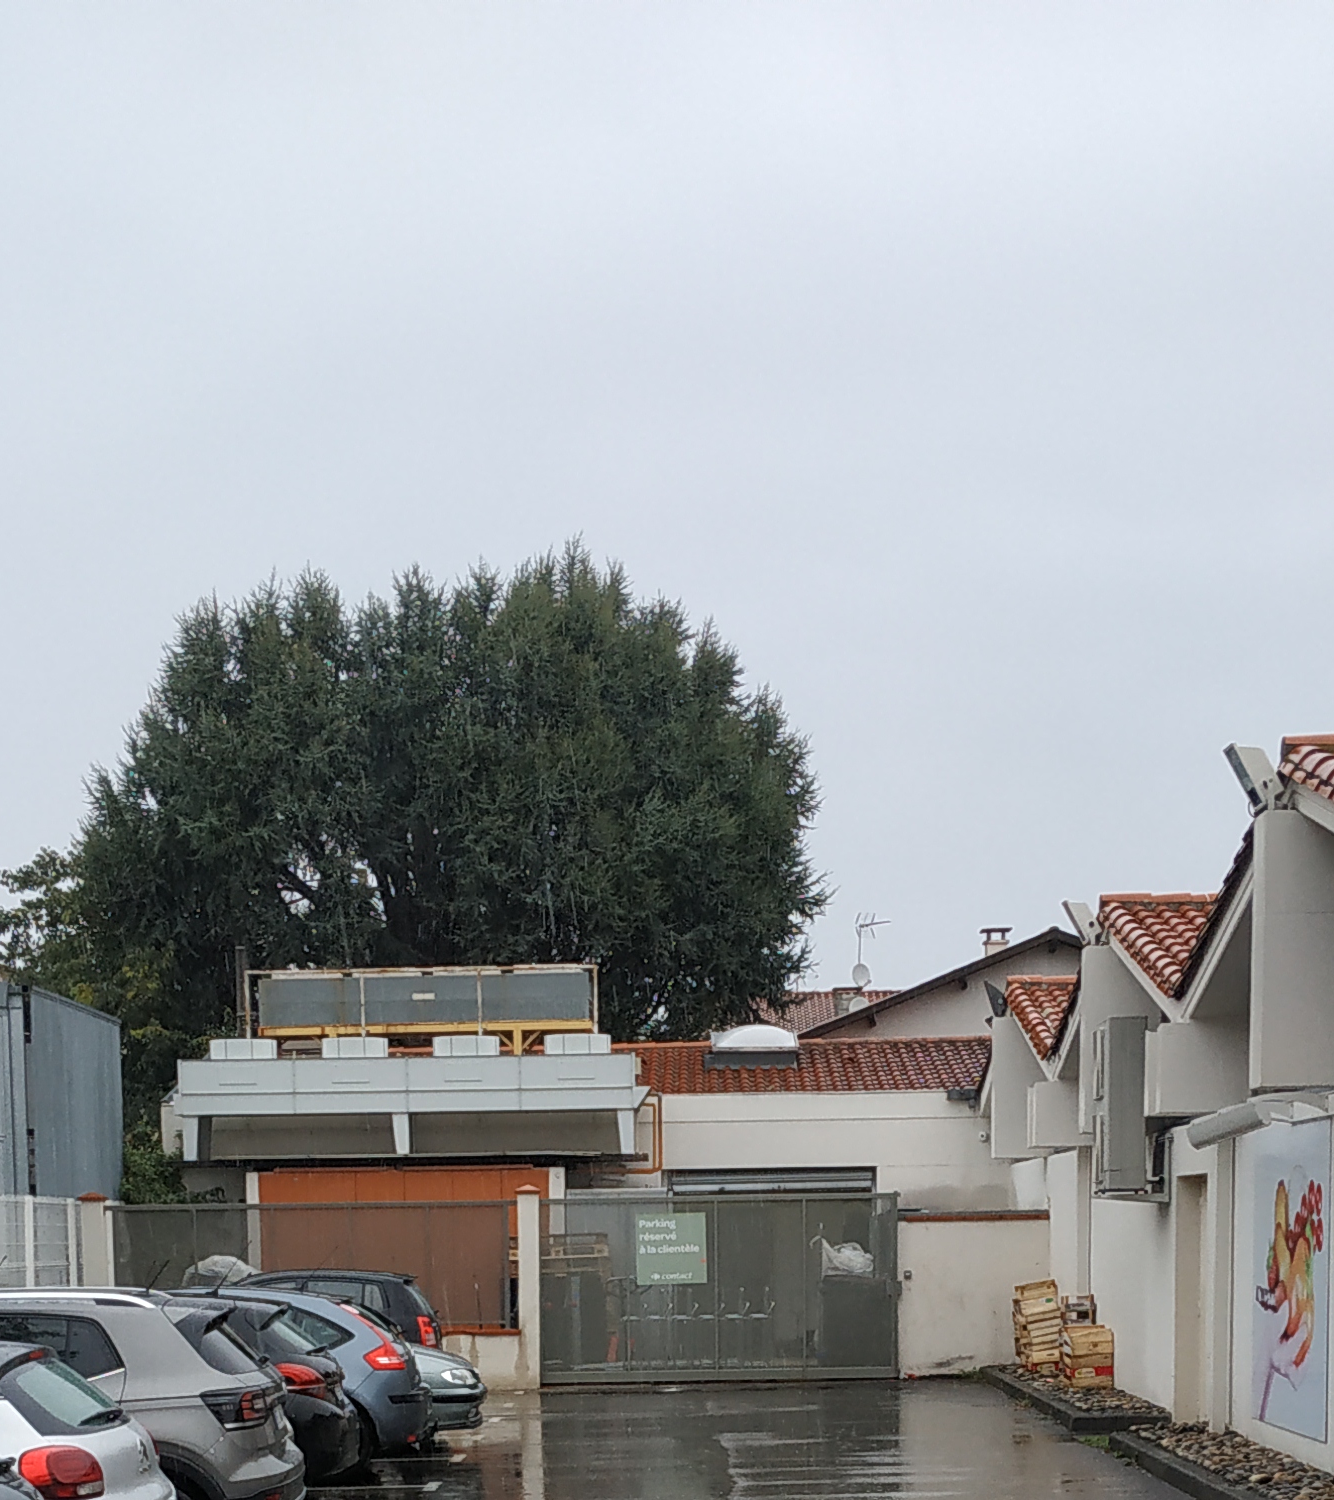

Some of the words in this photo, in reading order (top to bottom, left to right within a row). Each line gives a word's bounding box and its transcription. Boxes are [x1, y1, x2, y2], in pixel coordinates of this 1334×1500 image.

[639, 1219, 676, 1230] Parking
[639, 1231, 677, 1241] réservé
[639, 1245, 646, 1254] à
[647, 1245, 656, 1254] la
[657, 1243, 700, 1253] clientèle
[661, 1271, 693, 1280] contact
